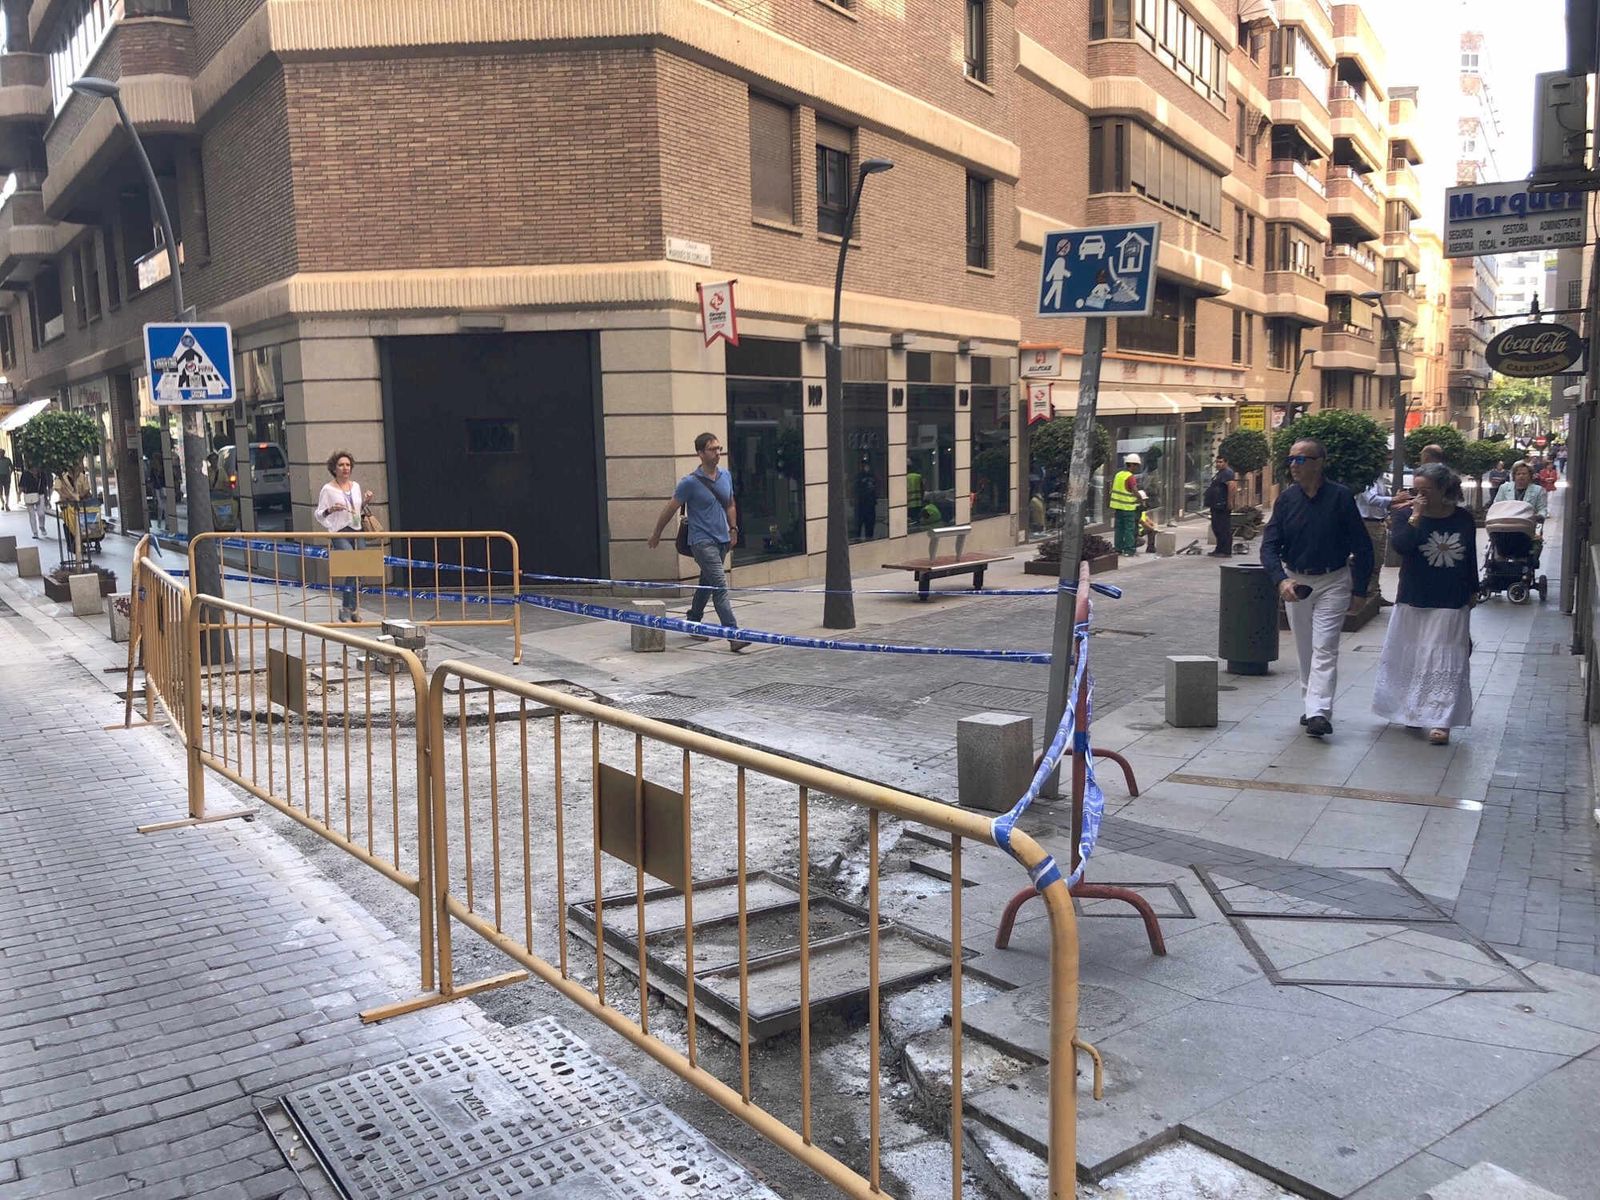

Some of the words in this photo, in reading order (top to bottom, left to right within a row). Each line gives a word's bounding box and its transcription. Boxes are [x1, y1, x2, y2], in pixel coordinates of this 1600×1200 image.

[1449, 229, 1474, 240] SEGUROS
[1479, 239, 1497, 250] FISCAL
[1508, 235, 1545, 248] EMPRESARIAL
[1553, 231, 1582, 243] CONTABLE
[1498, 331, 1569, 355] Coca-Cola
